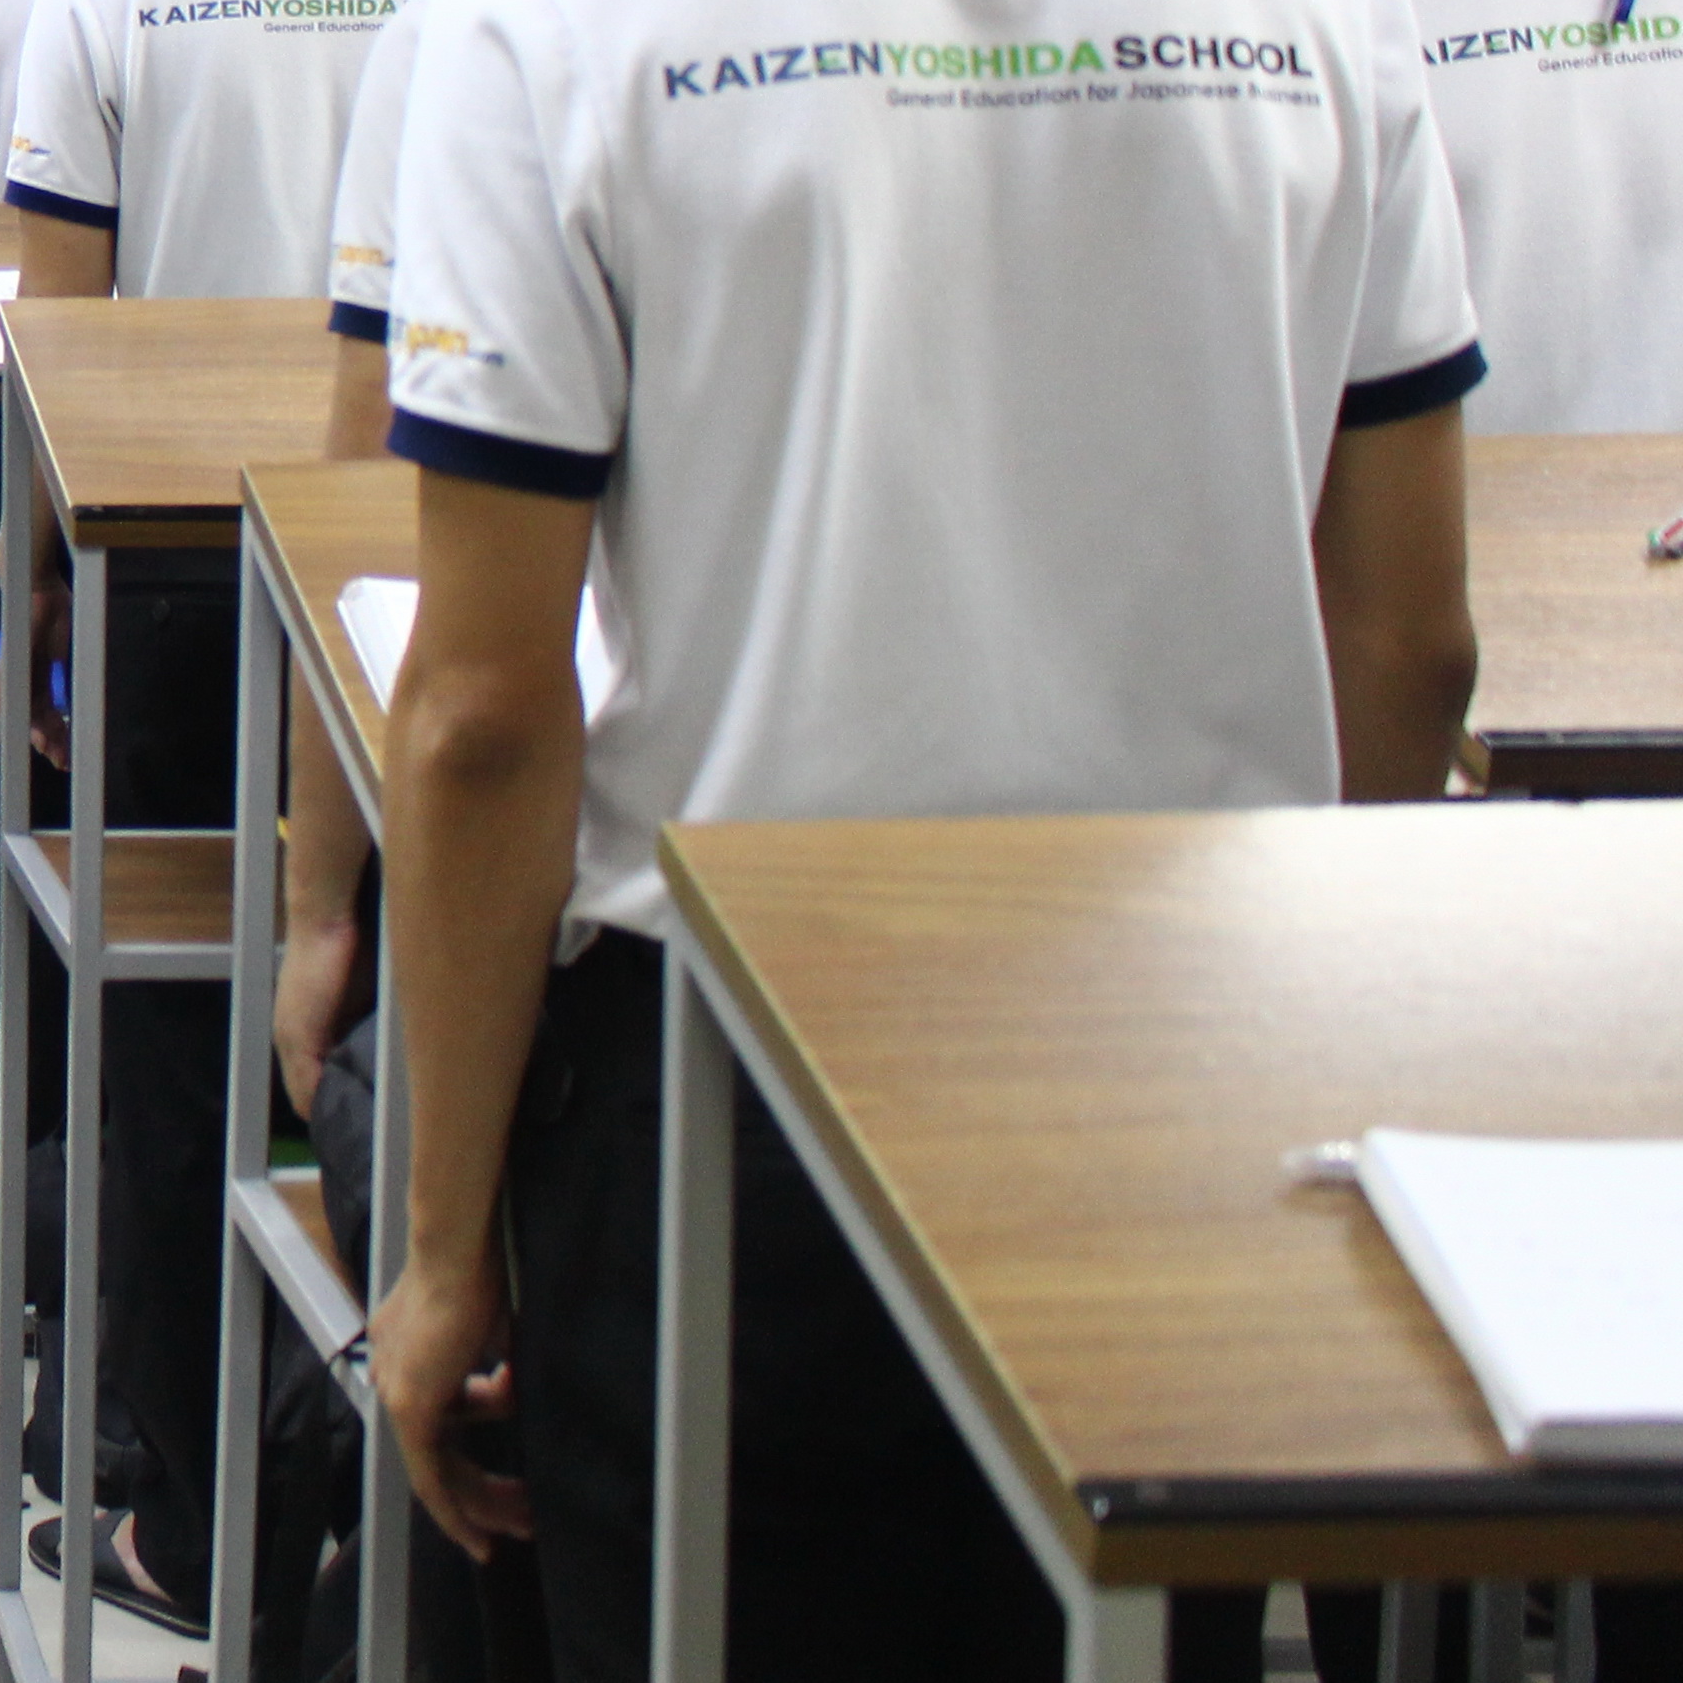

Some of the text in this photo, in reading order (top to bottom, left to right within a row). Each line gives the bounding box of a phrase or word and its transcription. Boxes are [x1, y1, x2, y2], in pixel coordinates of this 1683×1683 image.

[264, 21, 314, 33] General
[961, 85, 1081, 108] Education
[1087, 83, 1119, 102] for
[1126, 80, 1240, 101] Japanese
